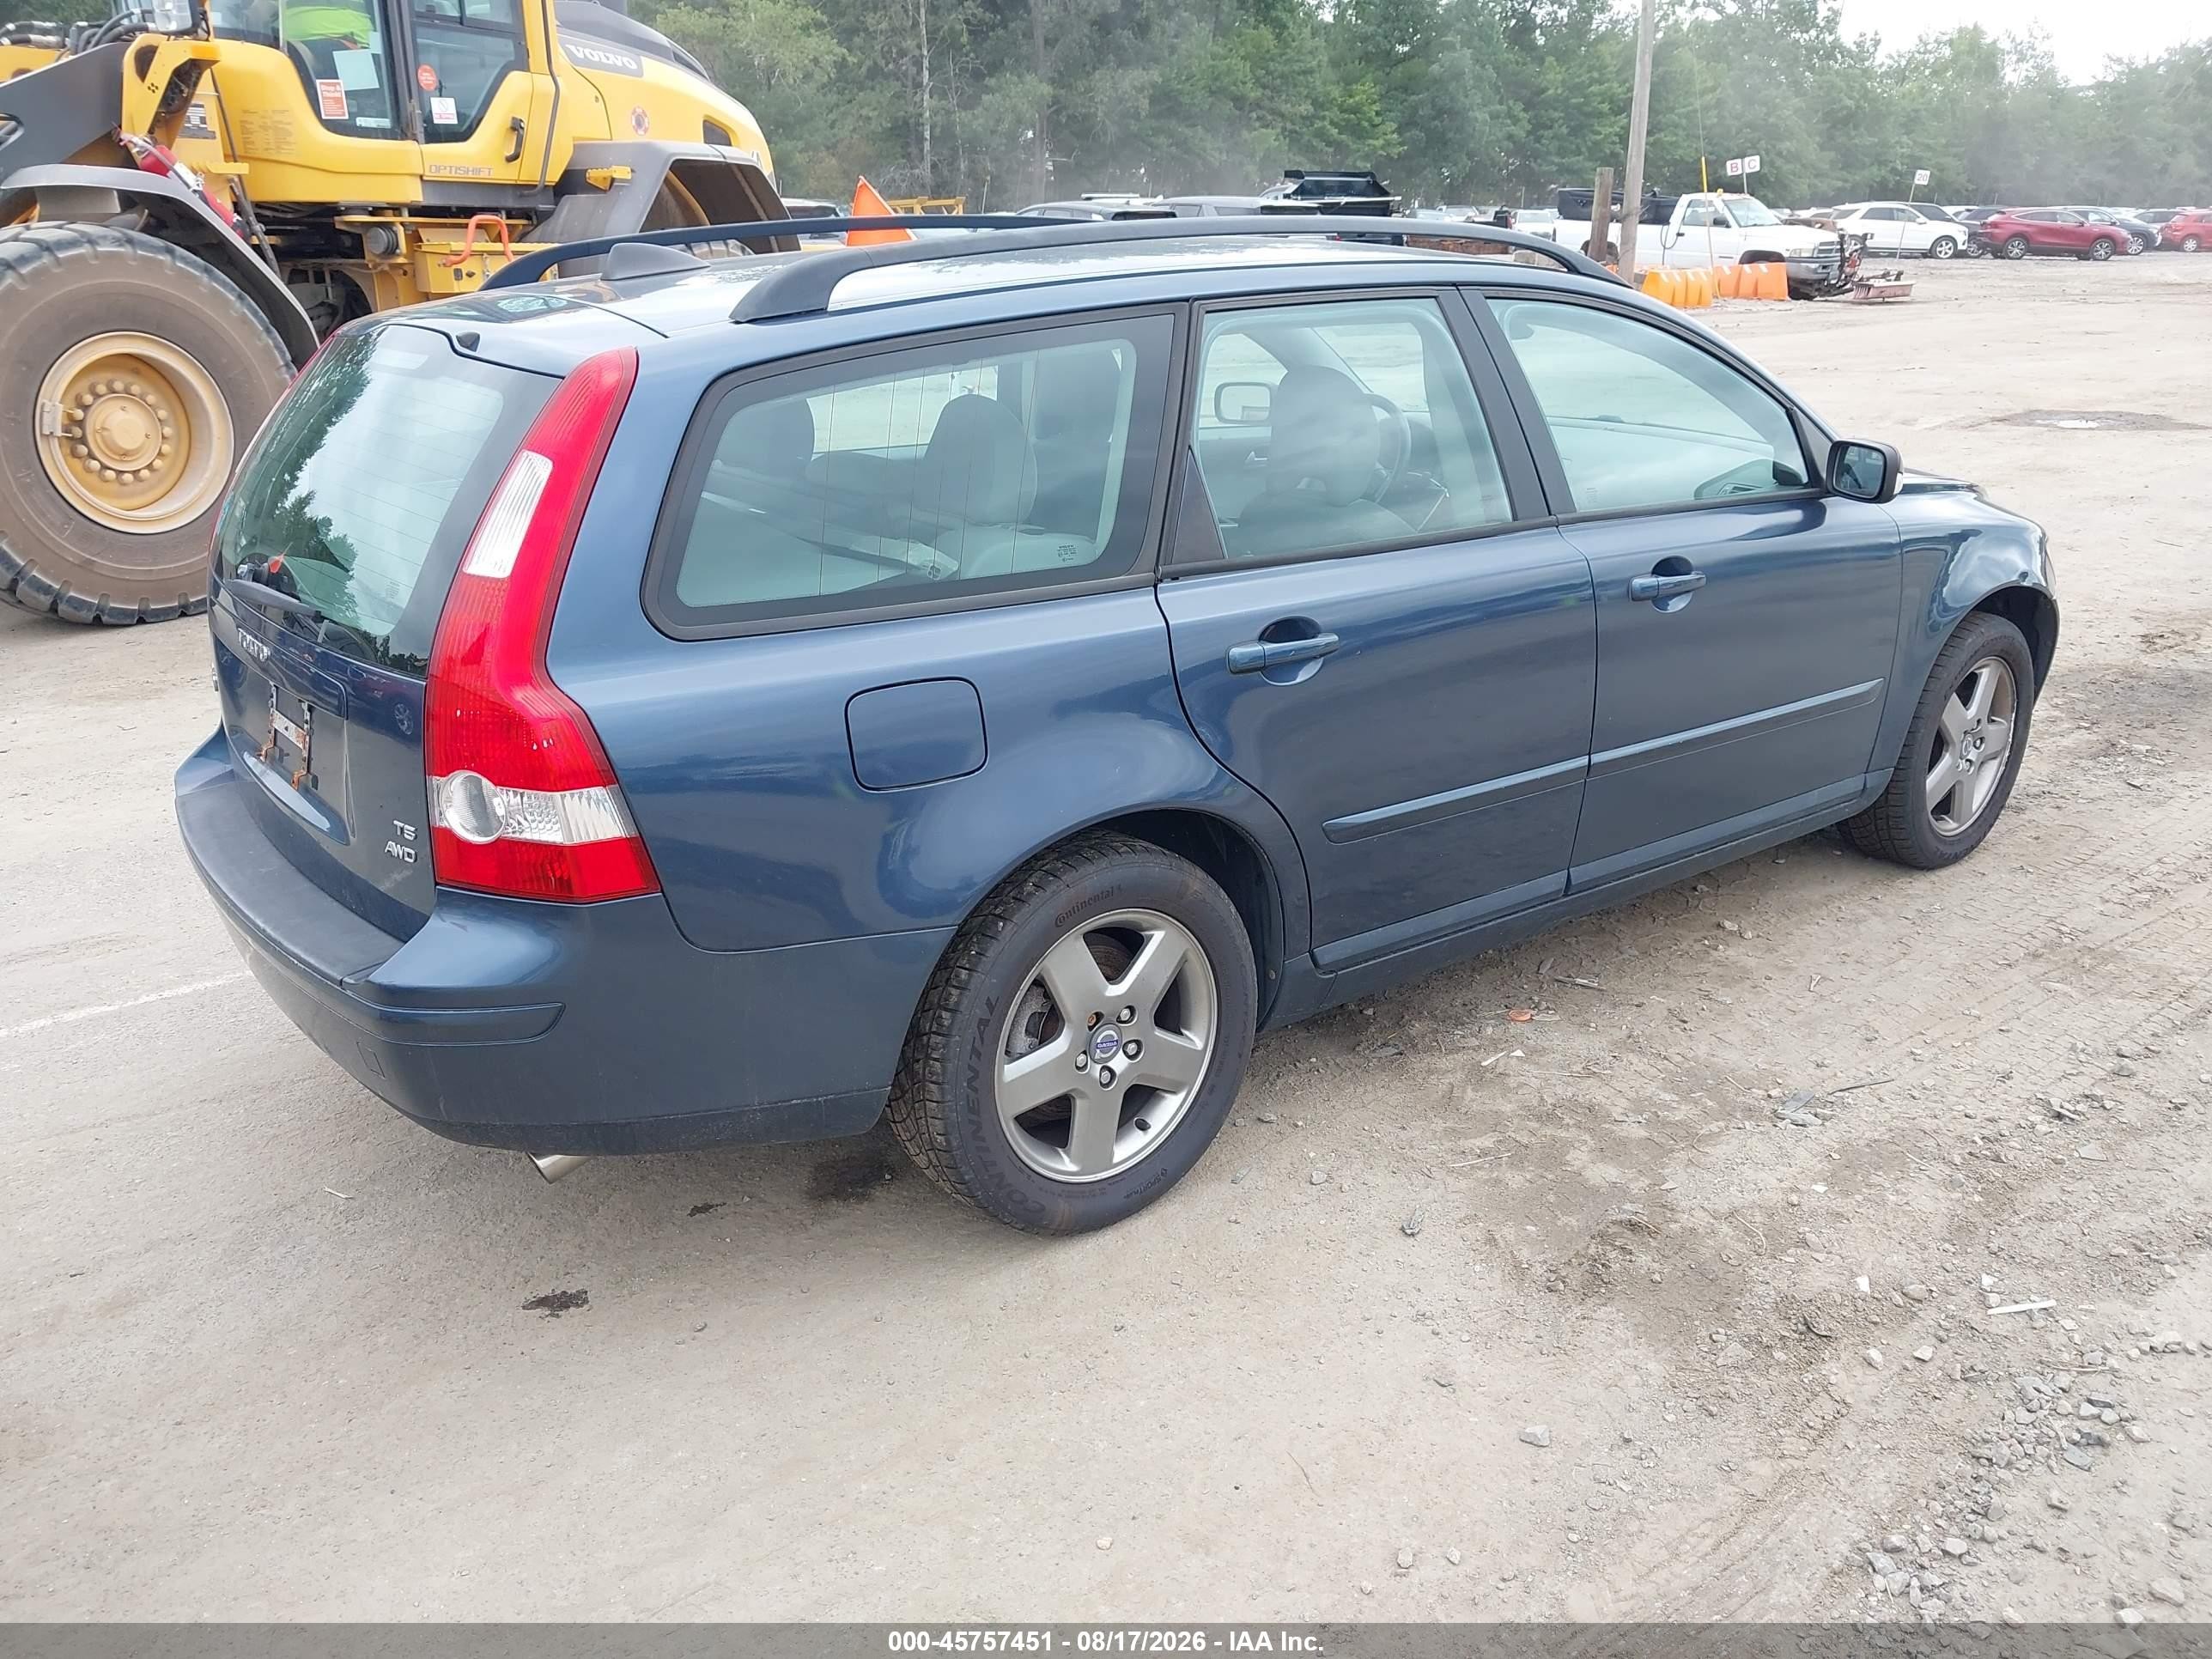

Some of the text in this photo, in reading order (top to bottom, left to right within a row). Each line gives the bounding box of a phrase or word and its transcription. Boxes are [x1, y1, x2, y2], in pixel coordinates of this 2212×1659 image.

[565, 44, 638, 70] VOLVO
[429, 164, 494, 177] OPTISHIFT
[1730, 162, 1739, 173] B
[1747, 159, 1757, 170] C
[1917, 173, 1929, 182] 20
[392, 819, 416, 842] T5
[384, 841, 416, 863] AWD
[1054, 885, 1115, 928] Continental
[966, 995, 1046, 1214] CONTINENTAL
